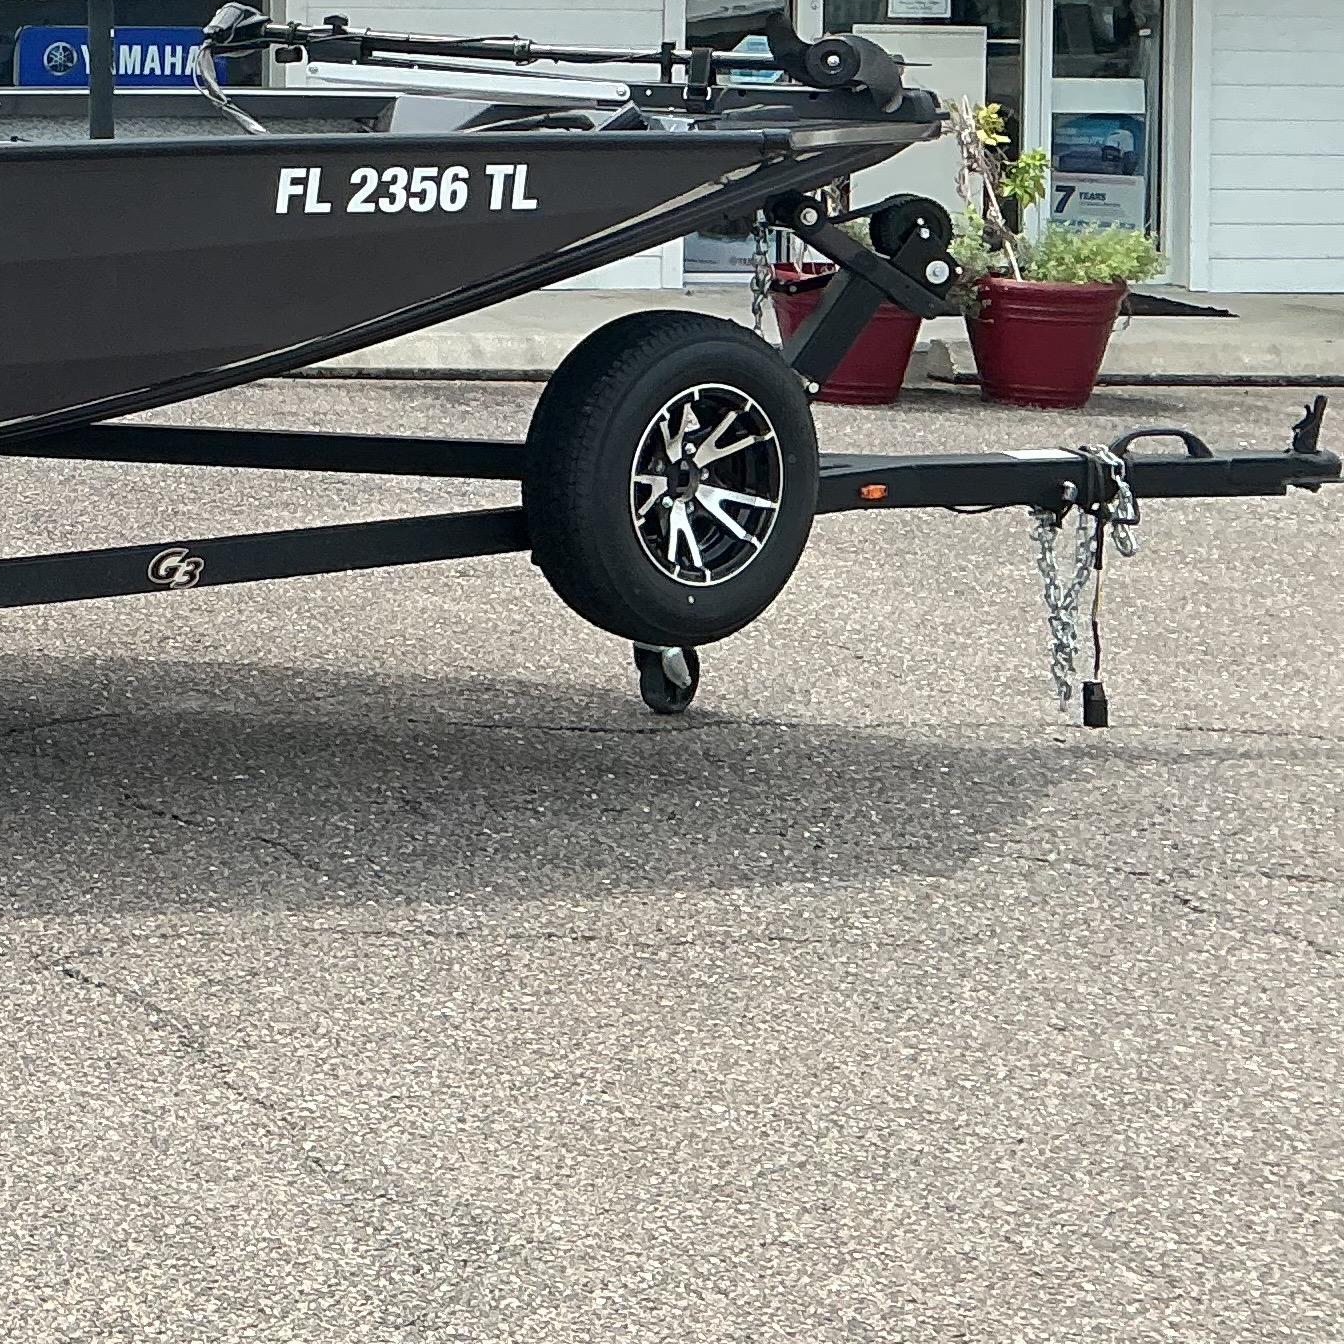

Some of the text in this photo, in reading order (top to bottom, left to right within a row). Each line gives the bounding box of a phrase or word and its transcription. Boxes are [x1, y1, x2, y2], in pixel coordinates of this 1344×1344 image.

[80, 44, 204, 76] YMAHA
[276, 164, 538, 214] FL 2356 TL
